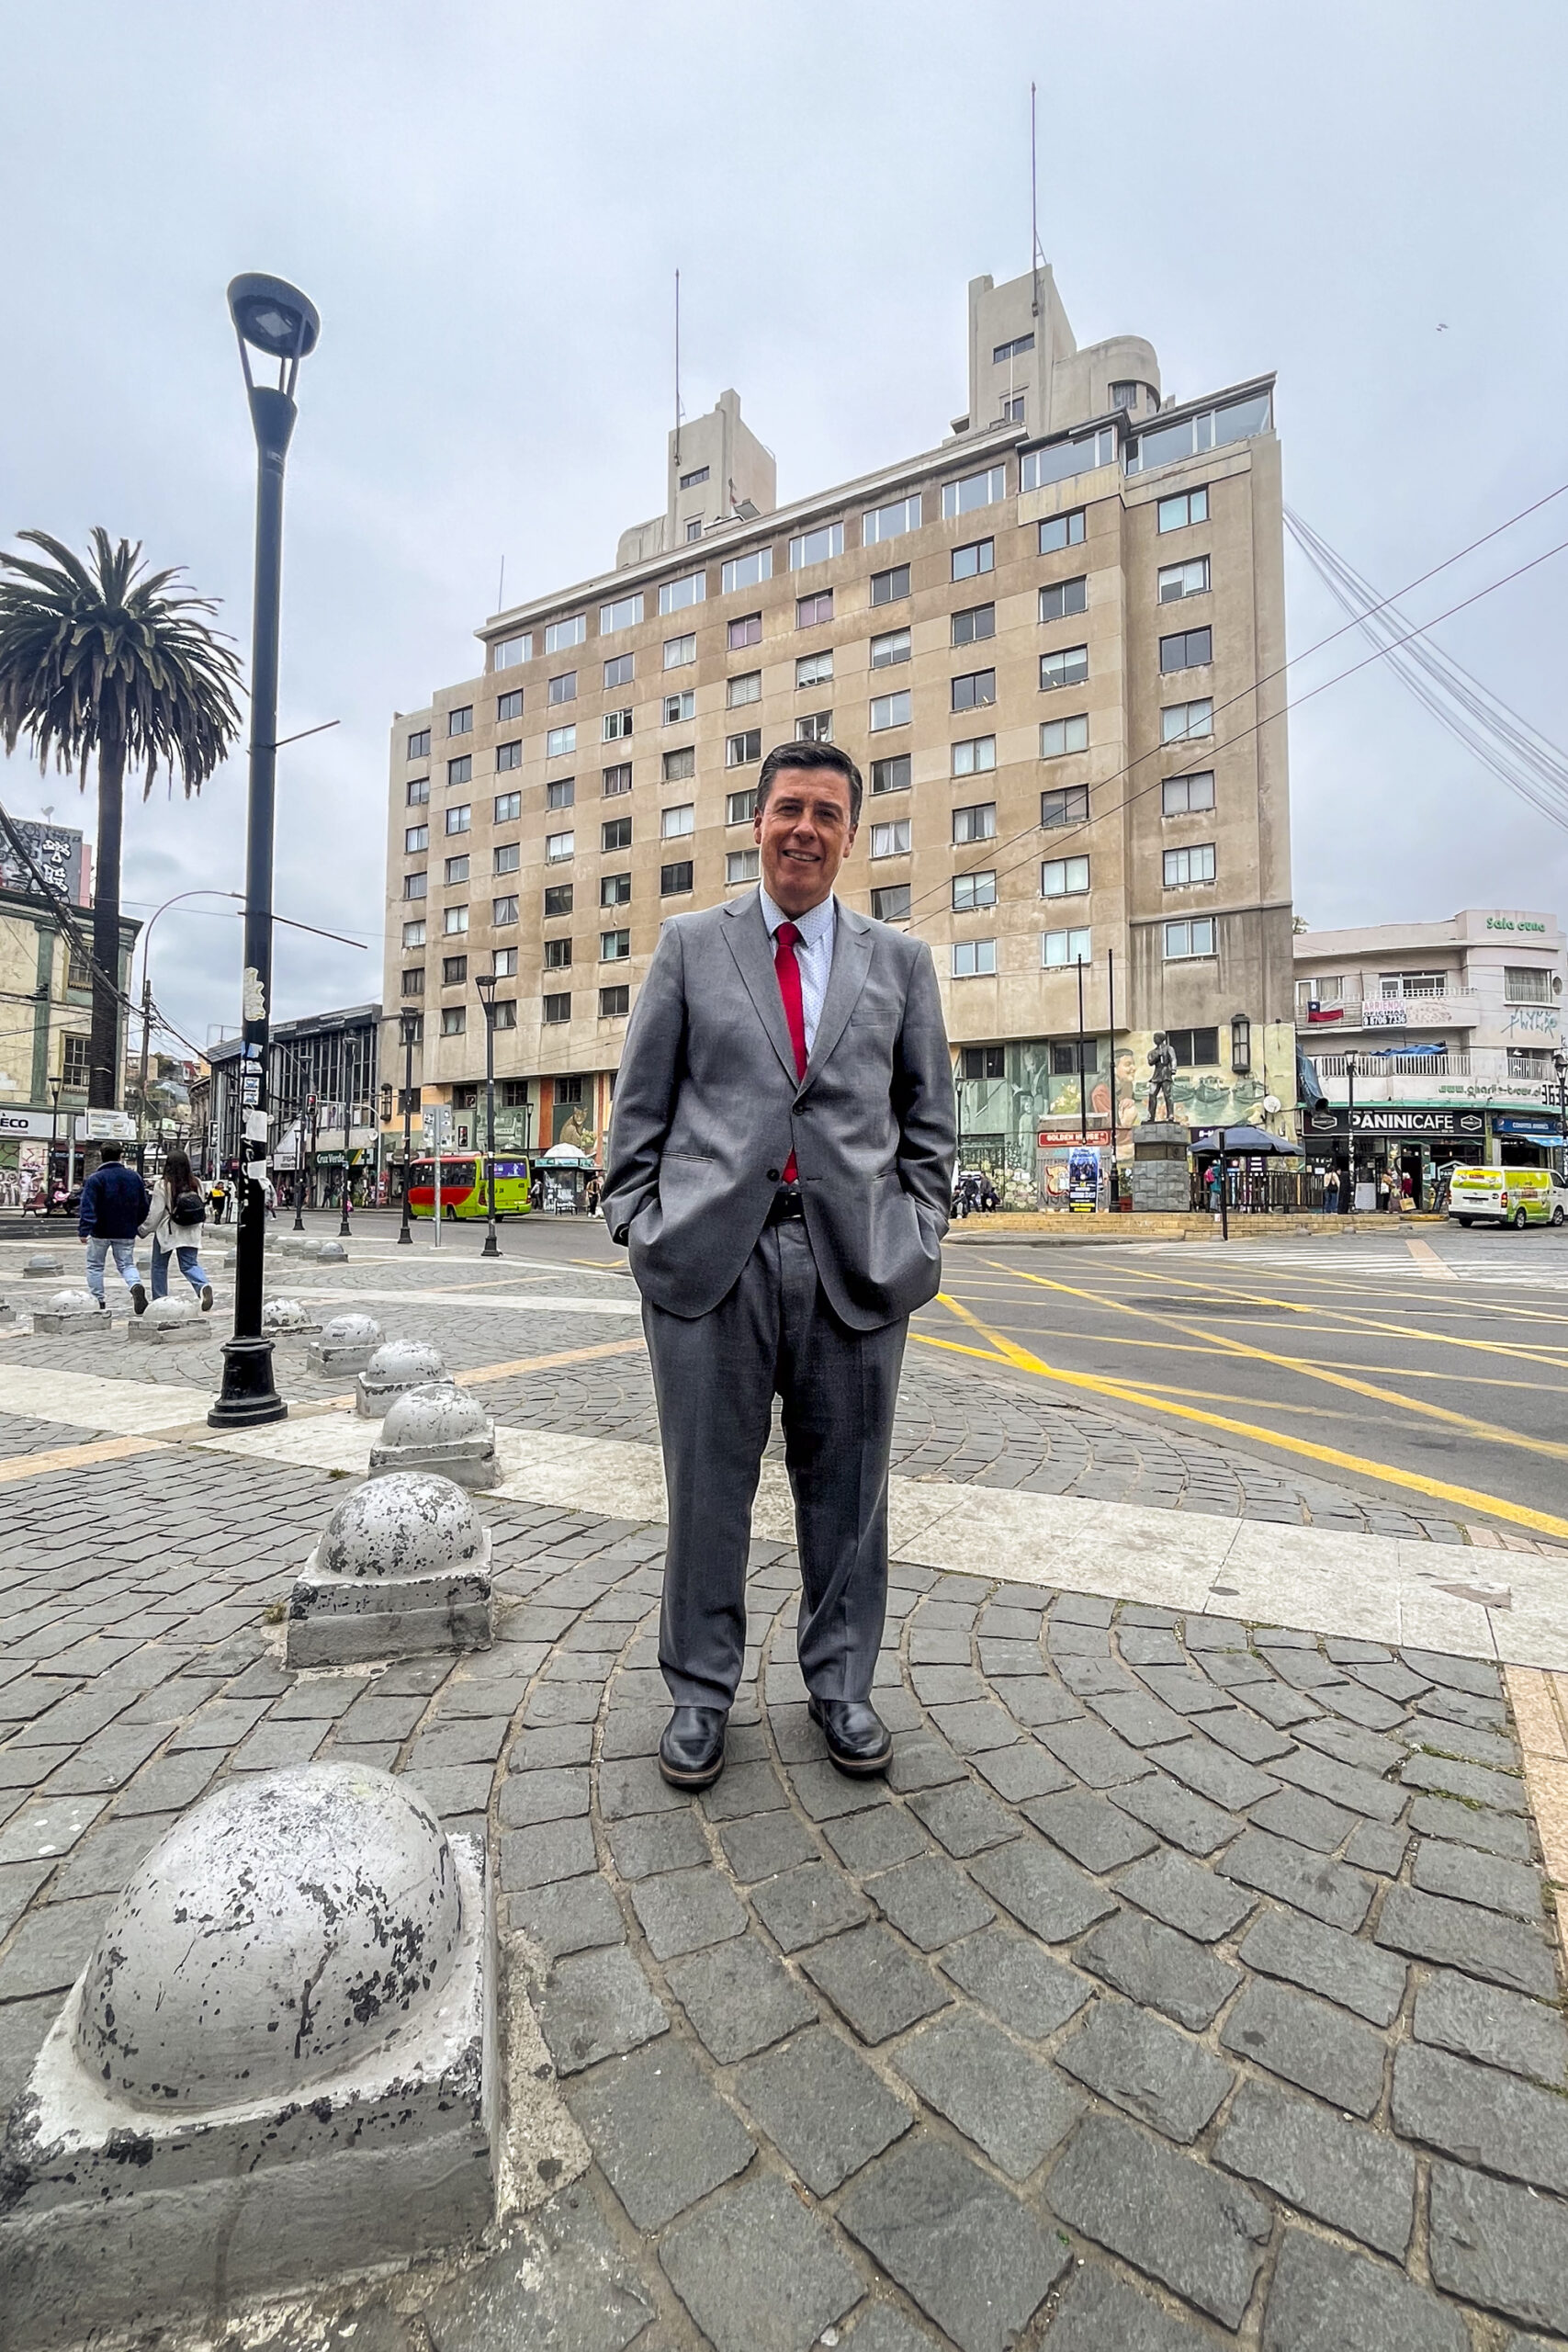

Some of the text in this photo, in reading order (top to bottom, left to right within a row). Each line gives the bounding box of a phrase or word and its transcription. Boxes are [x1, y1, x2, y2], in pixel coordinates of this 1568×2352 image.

[1486, 917, 1515, 931] Sala
[1364, 1001, 1404, 1011] ARRIENDO
[1046, 1133, 1100, 1142] GOLDEN HUSE
[316, 1152, 345, 1164] Cruz Verde
